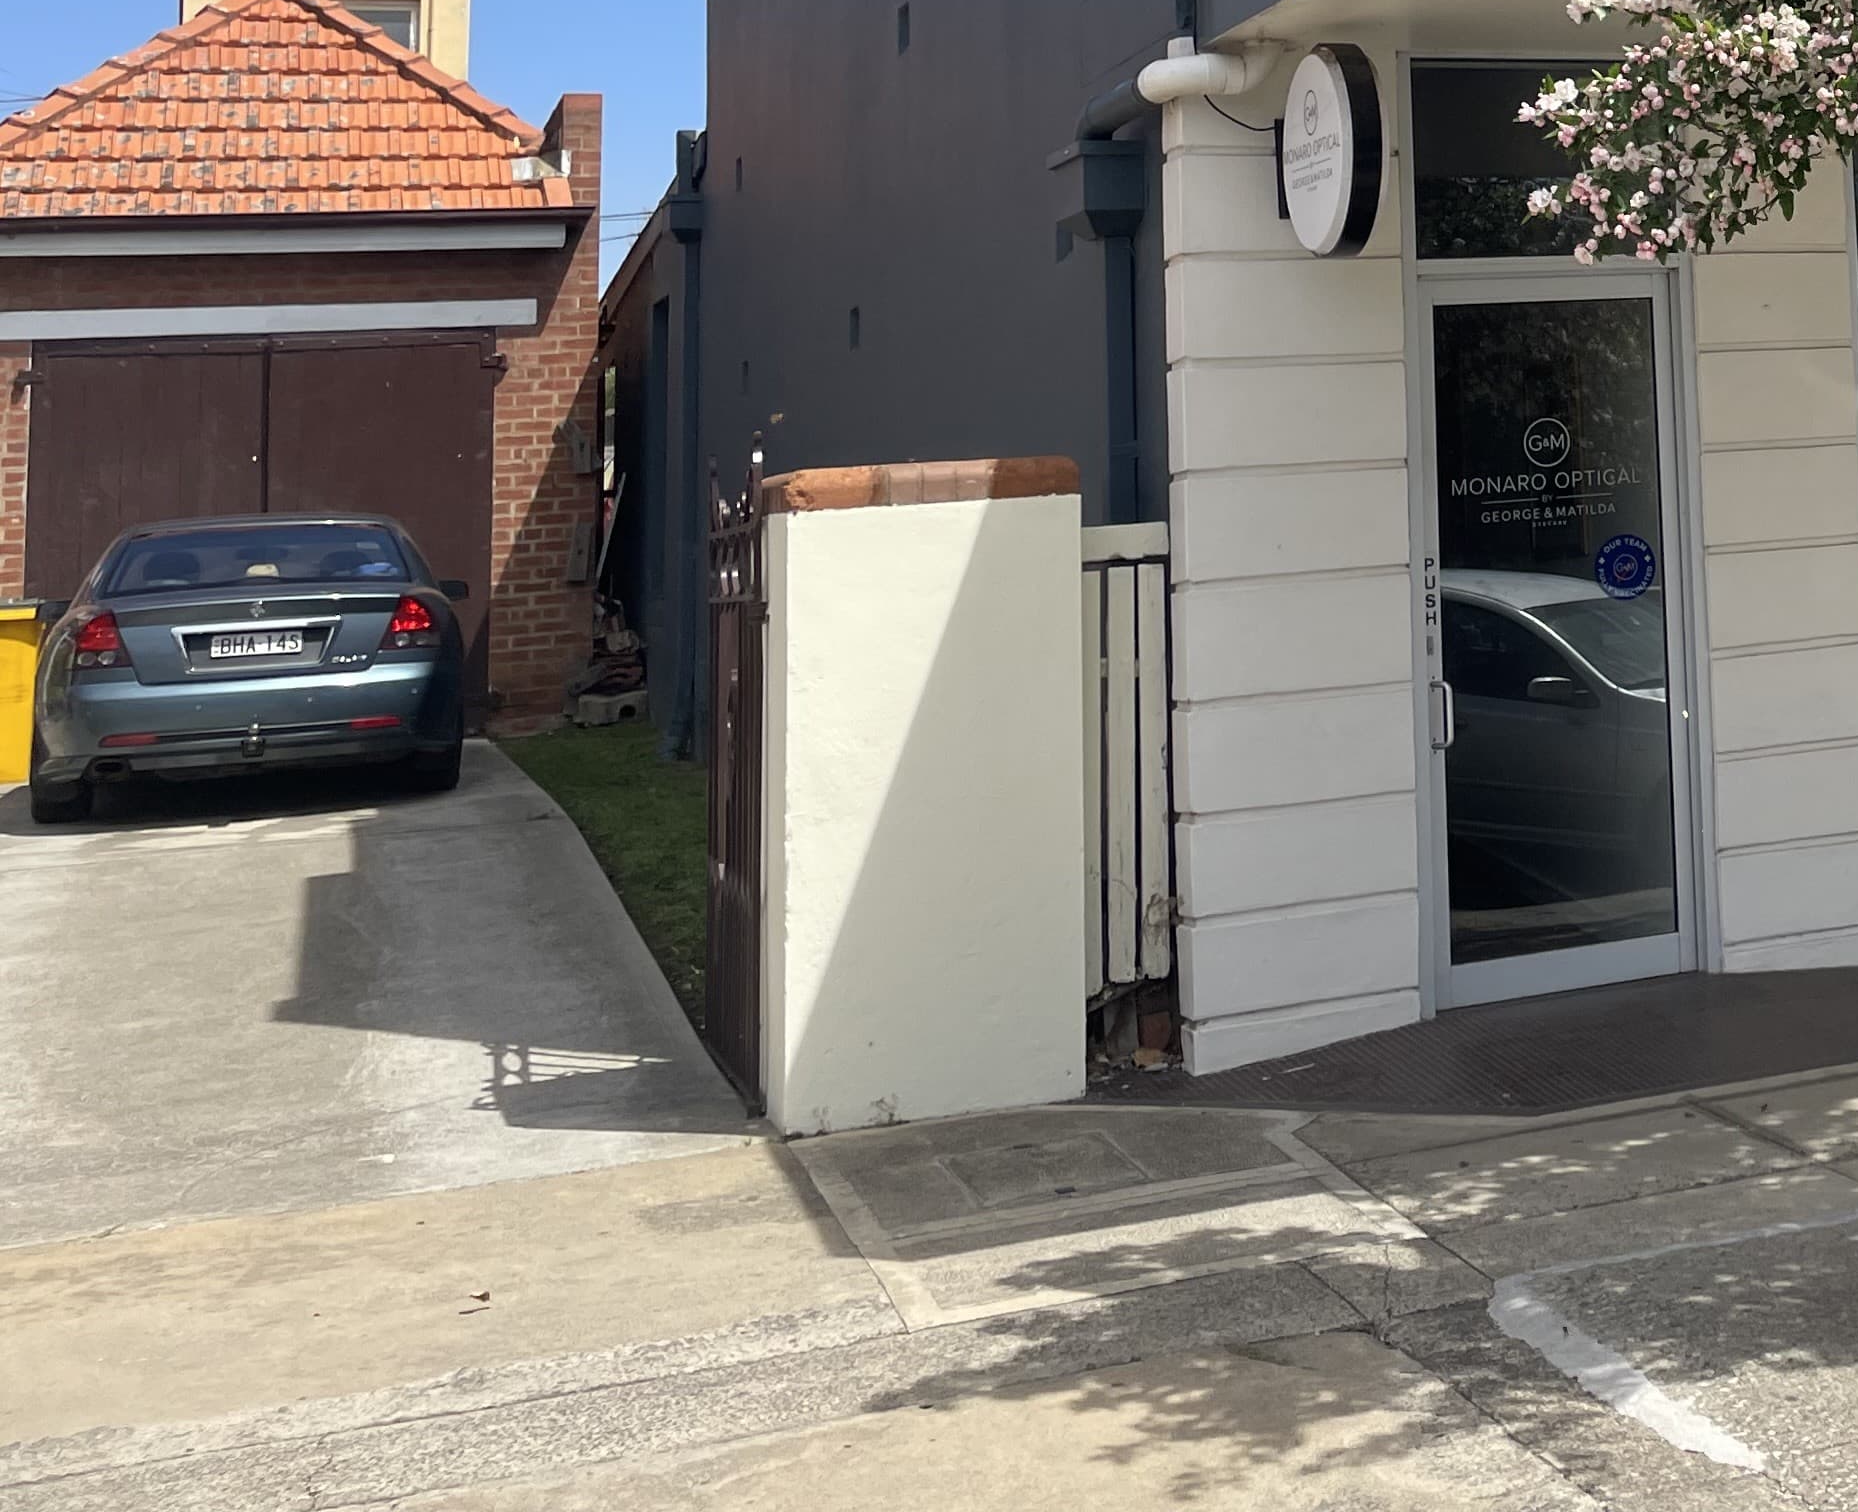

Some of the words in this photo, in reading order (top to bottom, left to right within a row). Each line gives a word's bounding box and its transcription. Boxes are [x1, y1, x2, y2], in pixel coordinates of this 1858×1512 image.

[1528, 433, 1565, 452] G&M
[1451, 473, 1547, 497] MONARO
[1554, 467, 1641, 489] OPTICAL
[1541, 494, 1553, 504] BY
[1481, 507, 1540, 523] GEORGE
[1544, 507, 1553, 519] &
[1556, 503, 1616, 517] MATILDA
[1603, 538, 1622, 554] OUR
[1624, 538, 1648, 551] TEAM
[1424, 557, 1437, 626] PUSH
